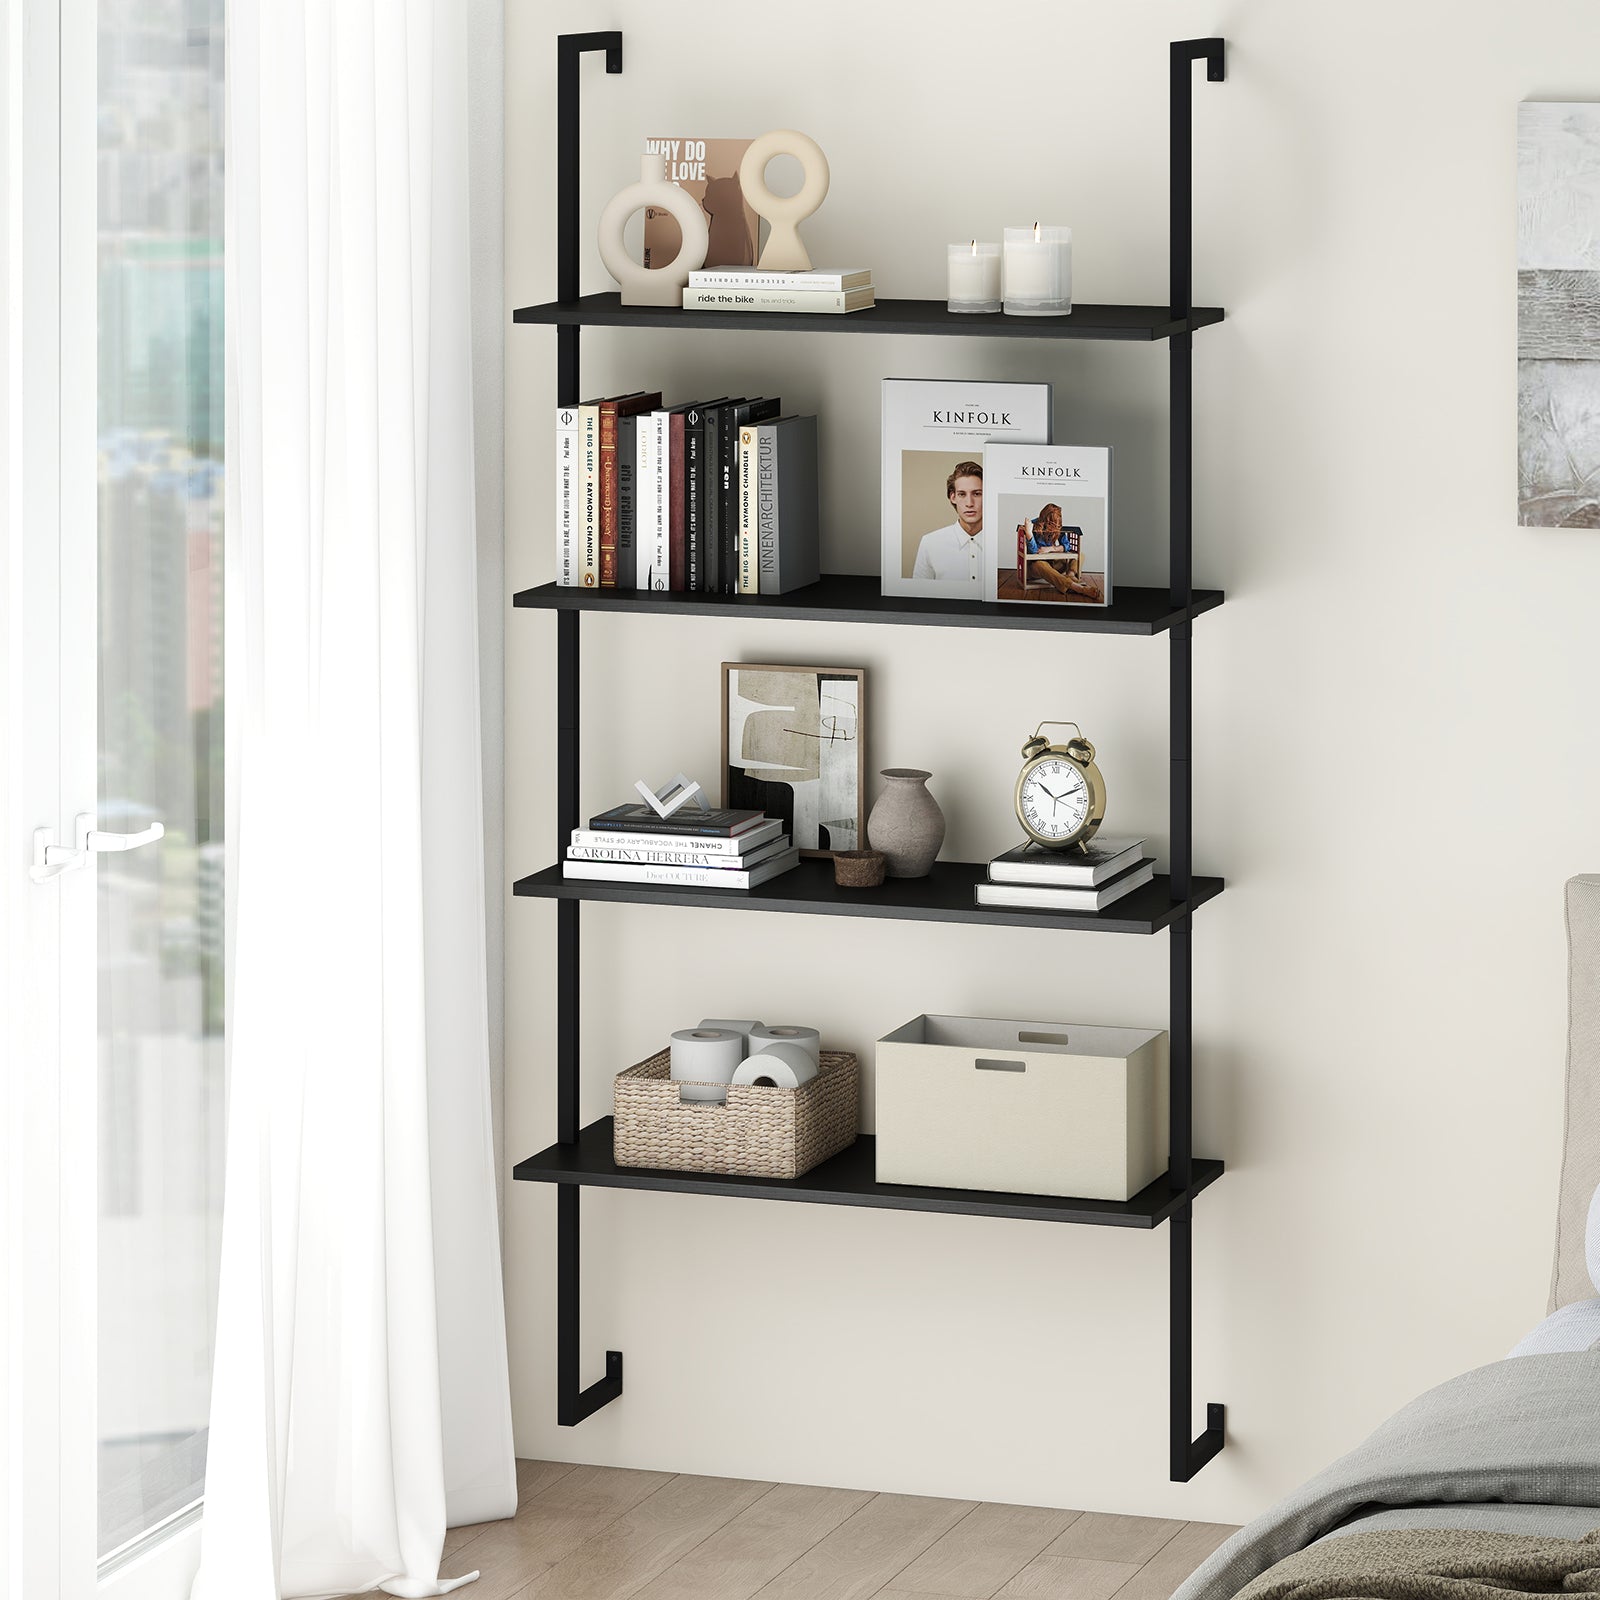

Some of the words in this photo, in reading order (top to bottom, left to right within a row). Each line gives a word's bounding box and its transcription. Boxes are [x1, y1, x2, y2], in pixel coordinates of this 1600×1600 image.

[646, 140, 680, 161] WHY
[685, 140, 706, 161] DO
[672, 162, 706, 181] LOVE
[698, 294, 716, 303] ride
[718, 295, 732, 303] the
[735, 295, 754, 304] bike
[933, 411, 1011, 425] KINFOLK
[621, 465, 632, 482] arts
[1022, 467, 1081, 478] KINFOLK
[760, 436, 774, 573] INNENARCHITEKTUR
[627, 838, 673, 847] VOCABULARY
[690, 842, 723, 850] CHANEL
[572, 848, 641, 861] CAROLINA
[646, 852, 709, 865] HERRERA
[646, 871, 663, 880] Dior
[665, 872, 709, 882] COUTURE
